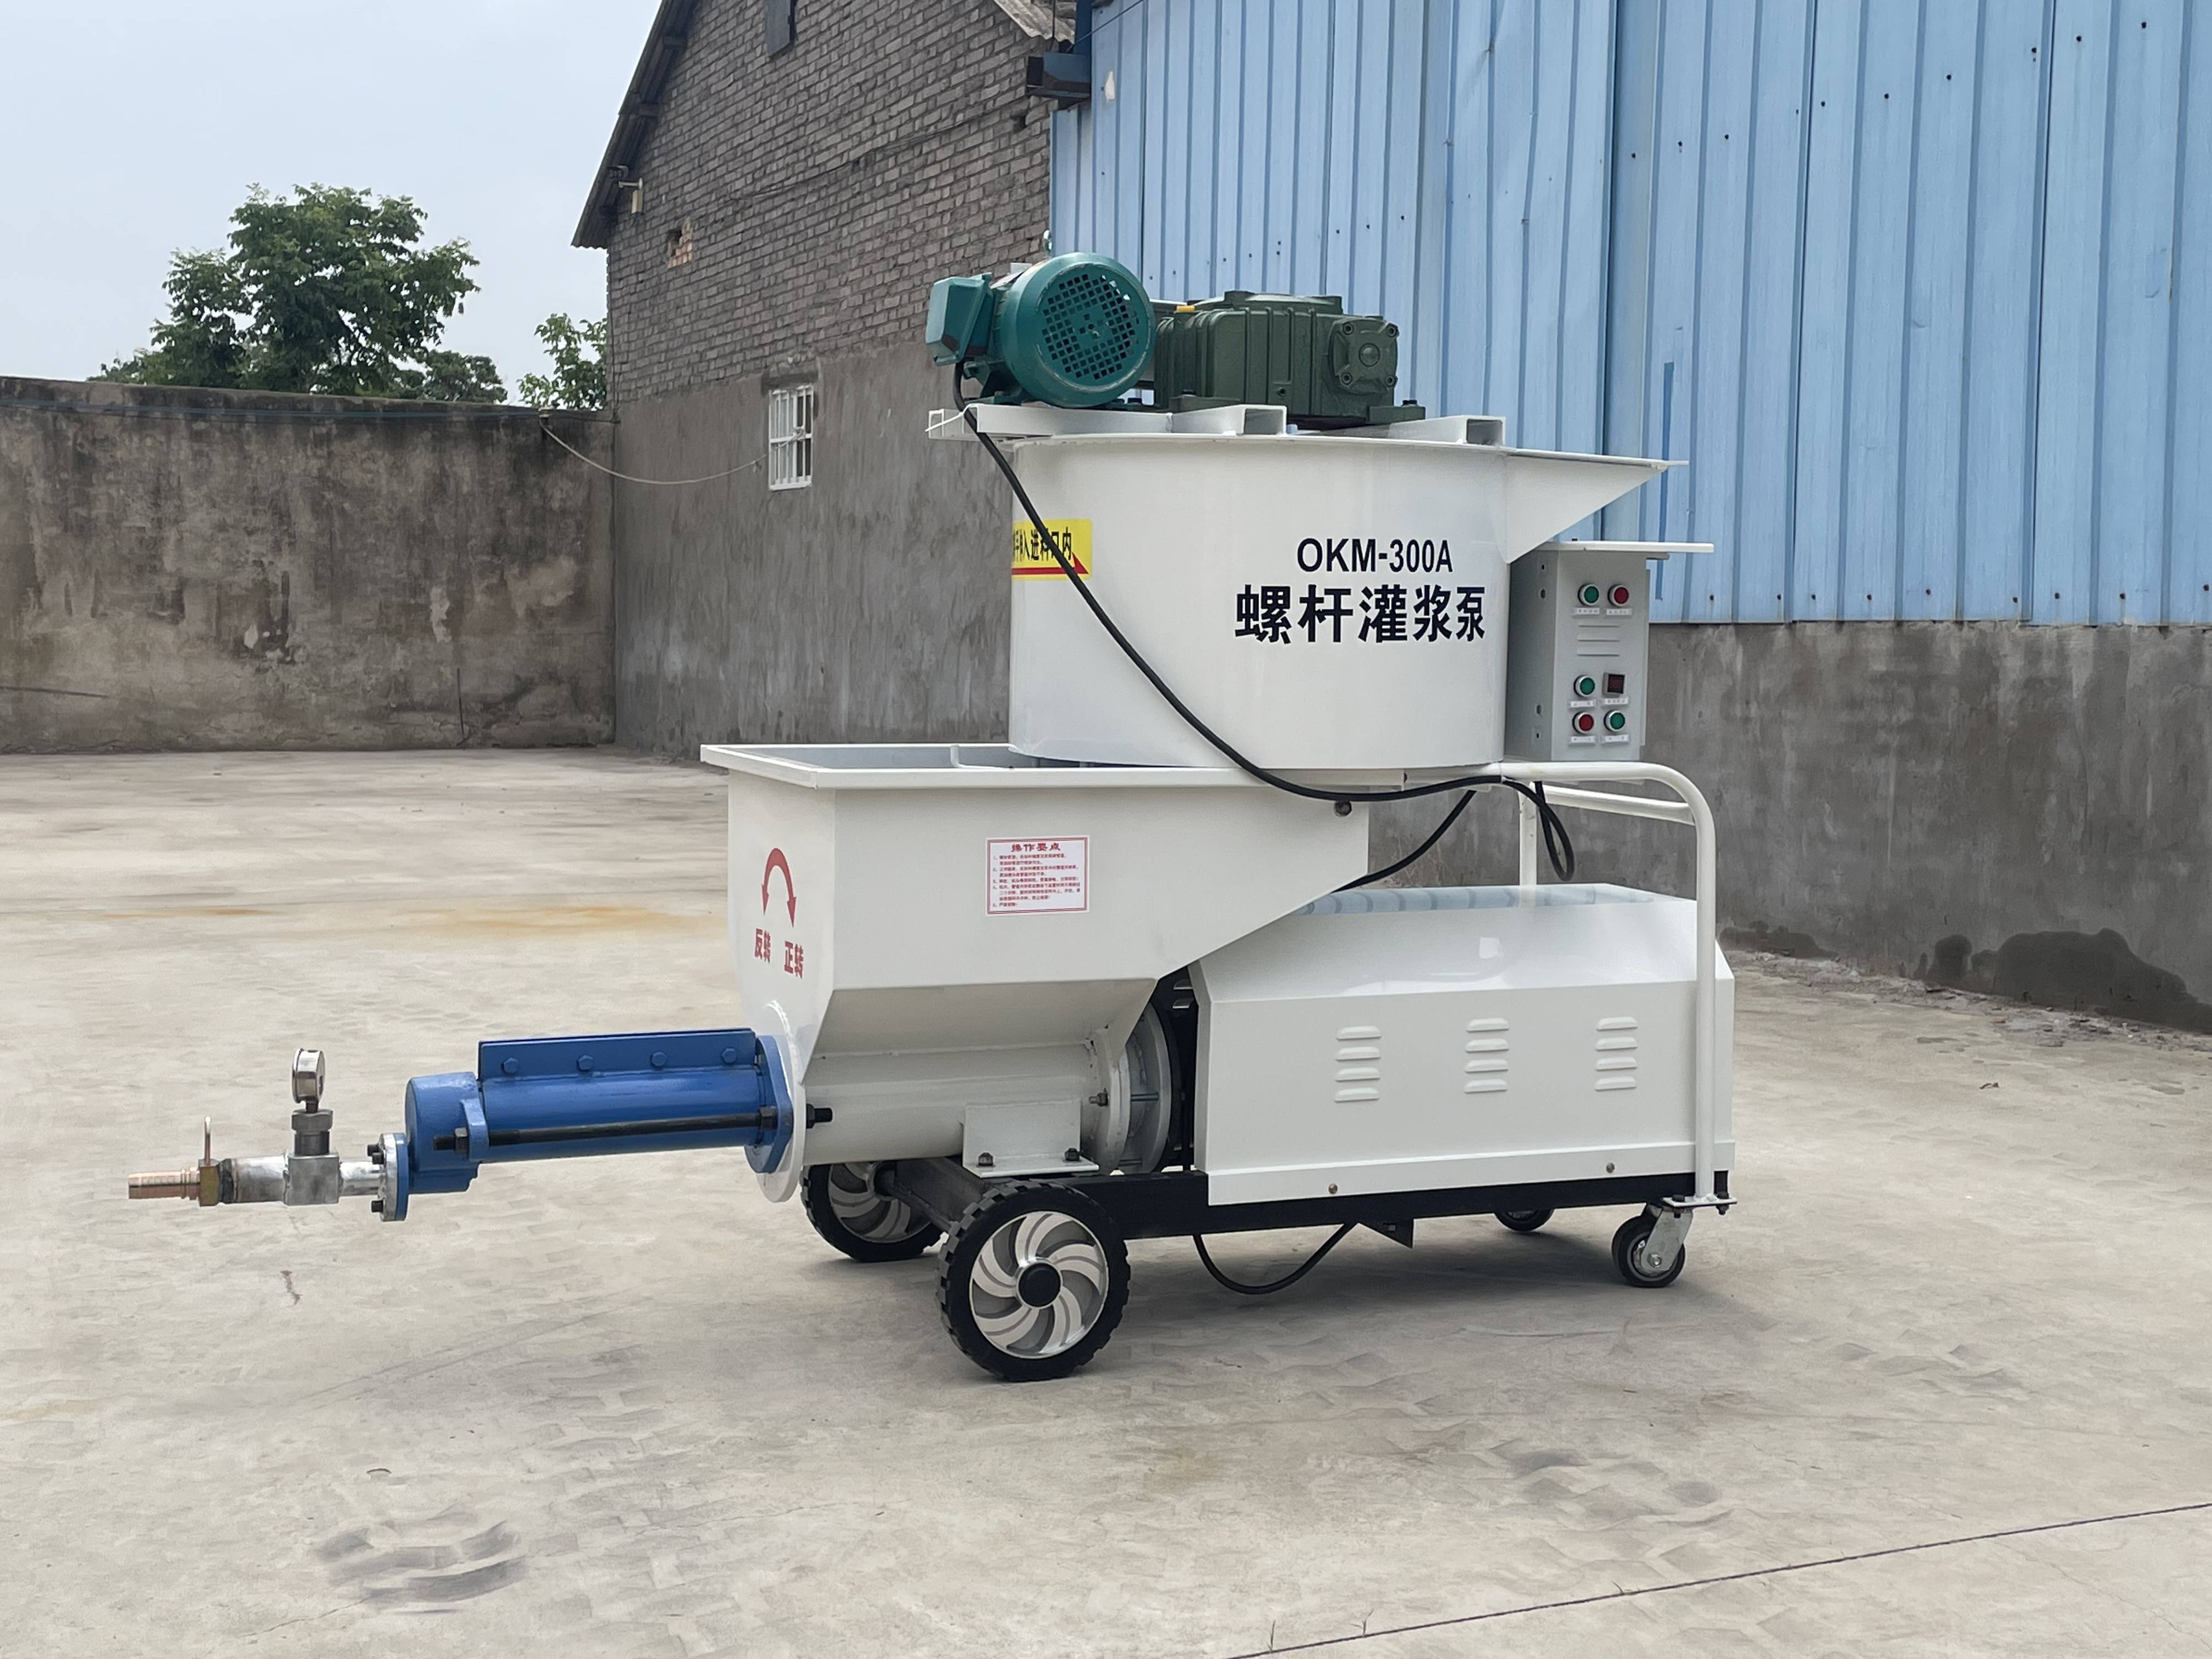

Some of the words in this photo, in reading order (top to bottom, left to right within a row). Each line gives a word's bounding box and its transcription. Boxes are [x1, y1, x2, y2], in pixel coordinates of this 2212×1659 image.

[1297, 538, 1453, 573] OKM-300A
[1235, 584, 1486, 644] 螺杆灌浆泵
[1011, 843, 1061, 852] 操作要点
[754, 928, 771, 964] 反转
[784, 940, 804, 979] 正转
